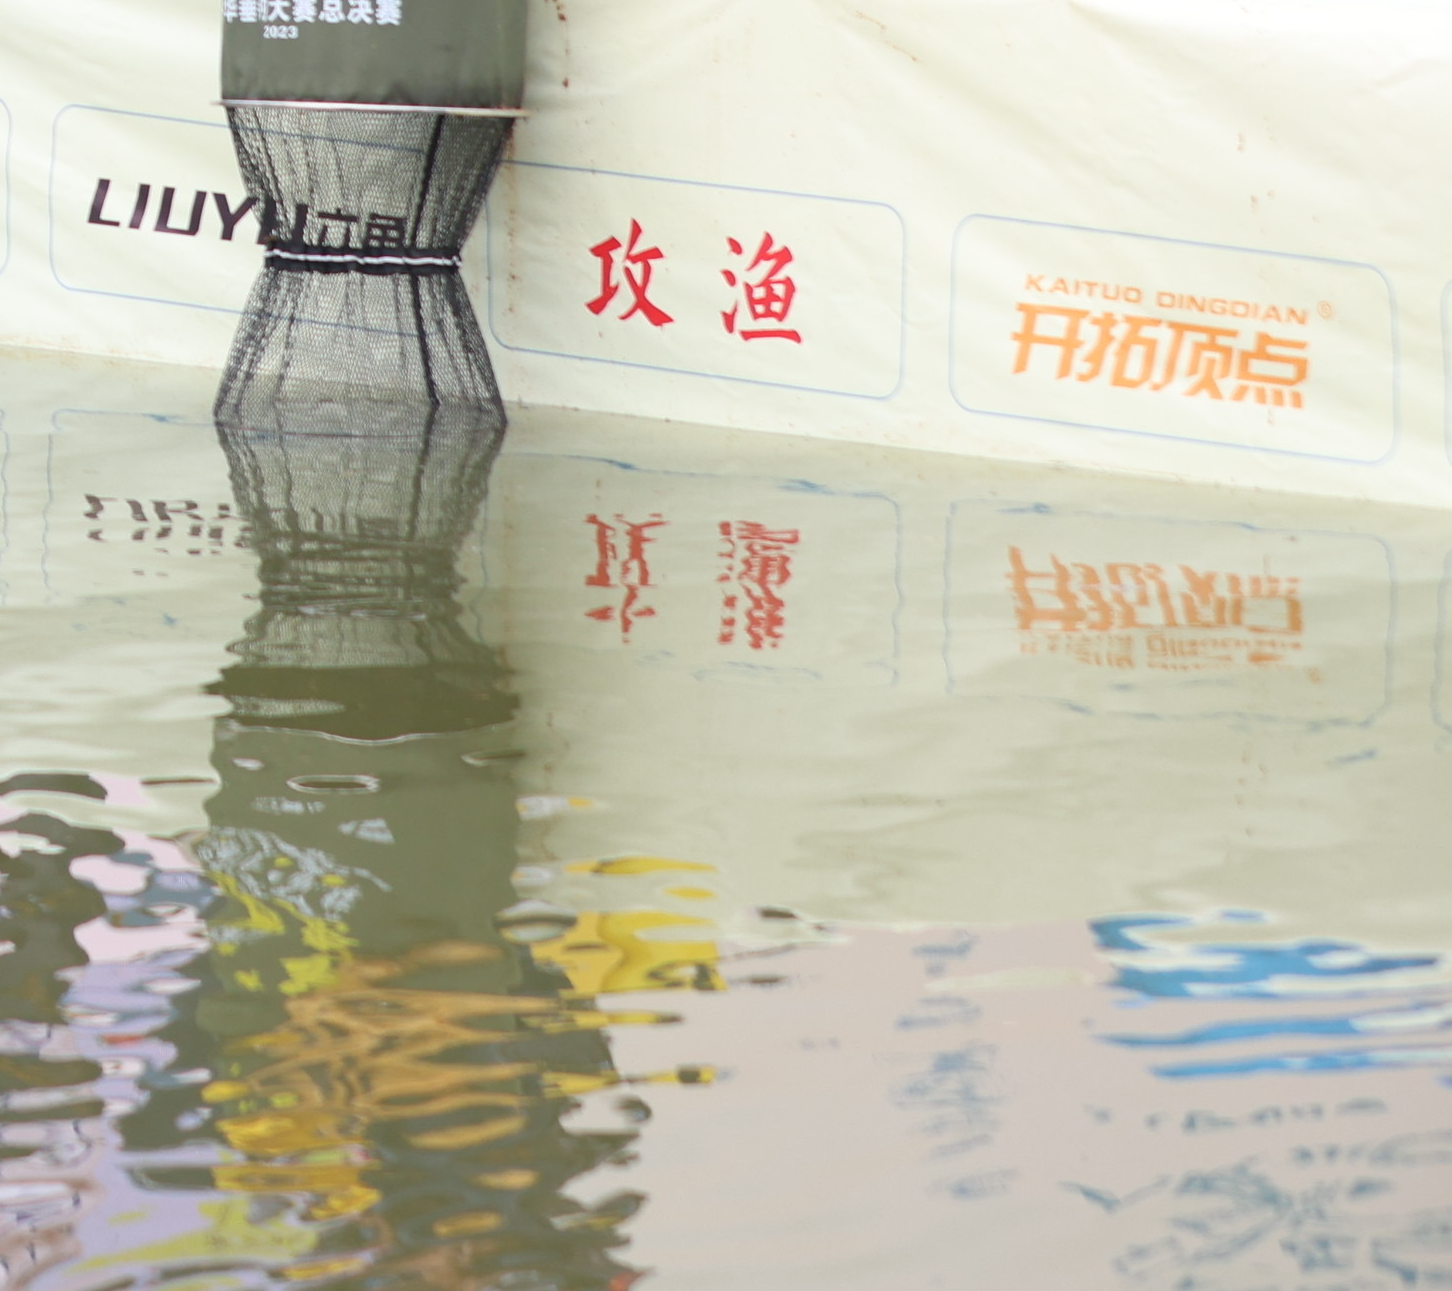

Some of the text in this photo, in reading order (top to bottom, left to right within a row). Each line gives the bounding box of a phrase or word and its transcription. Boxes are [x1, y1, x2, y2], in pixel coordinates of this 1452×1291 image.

[1023, 274, 1308, 326] KAITUO DINGDIAN
[1011, 300, 1310, 409] 开拓顶点
